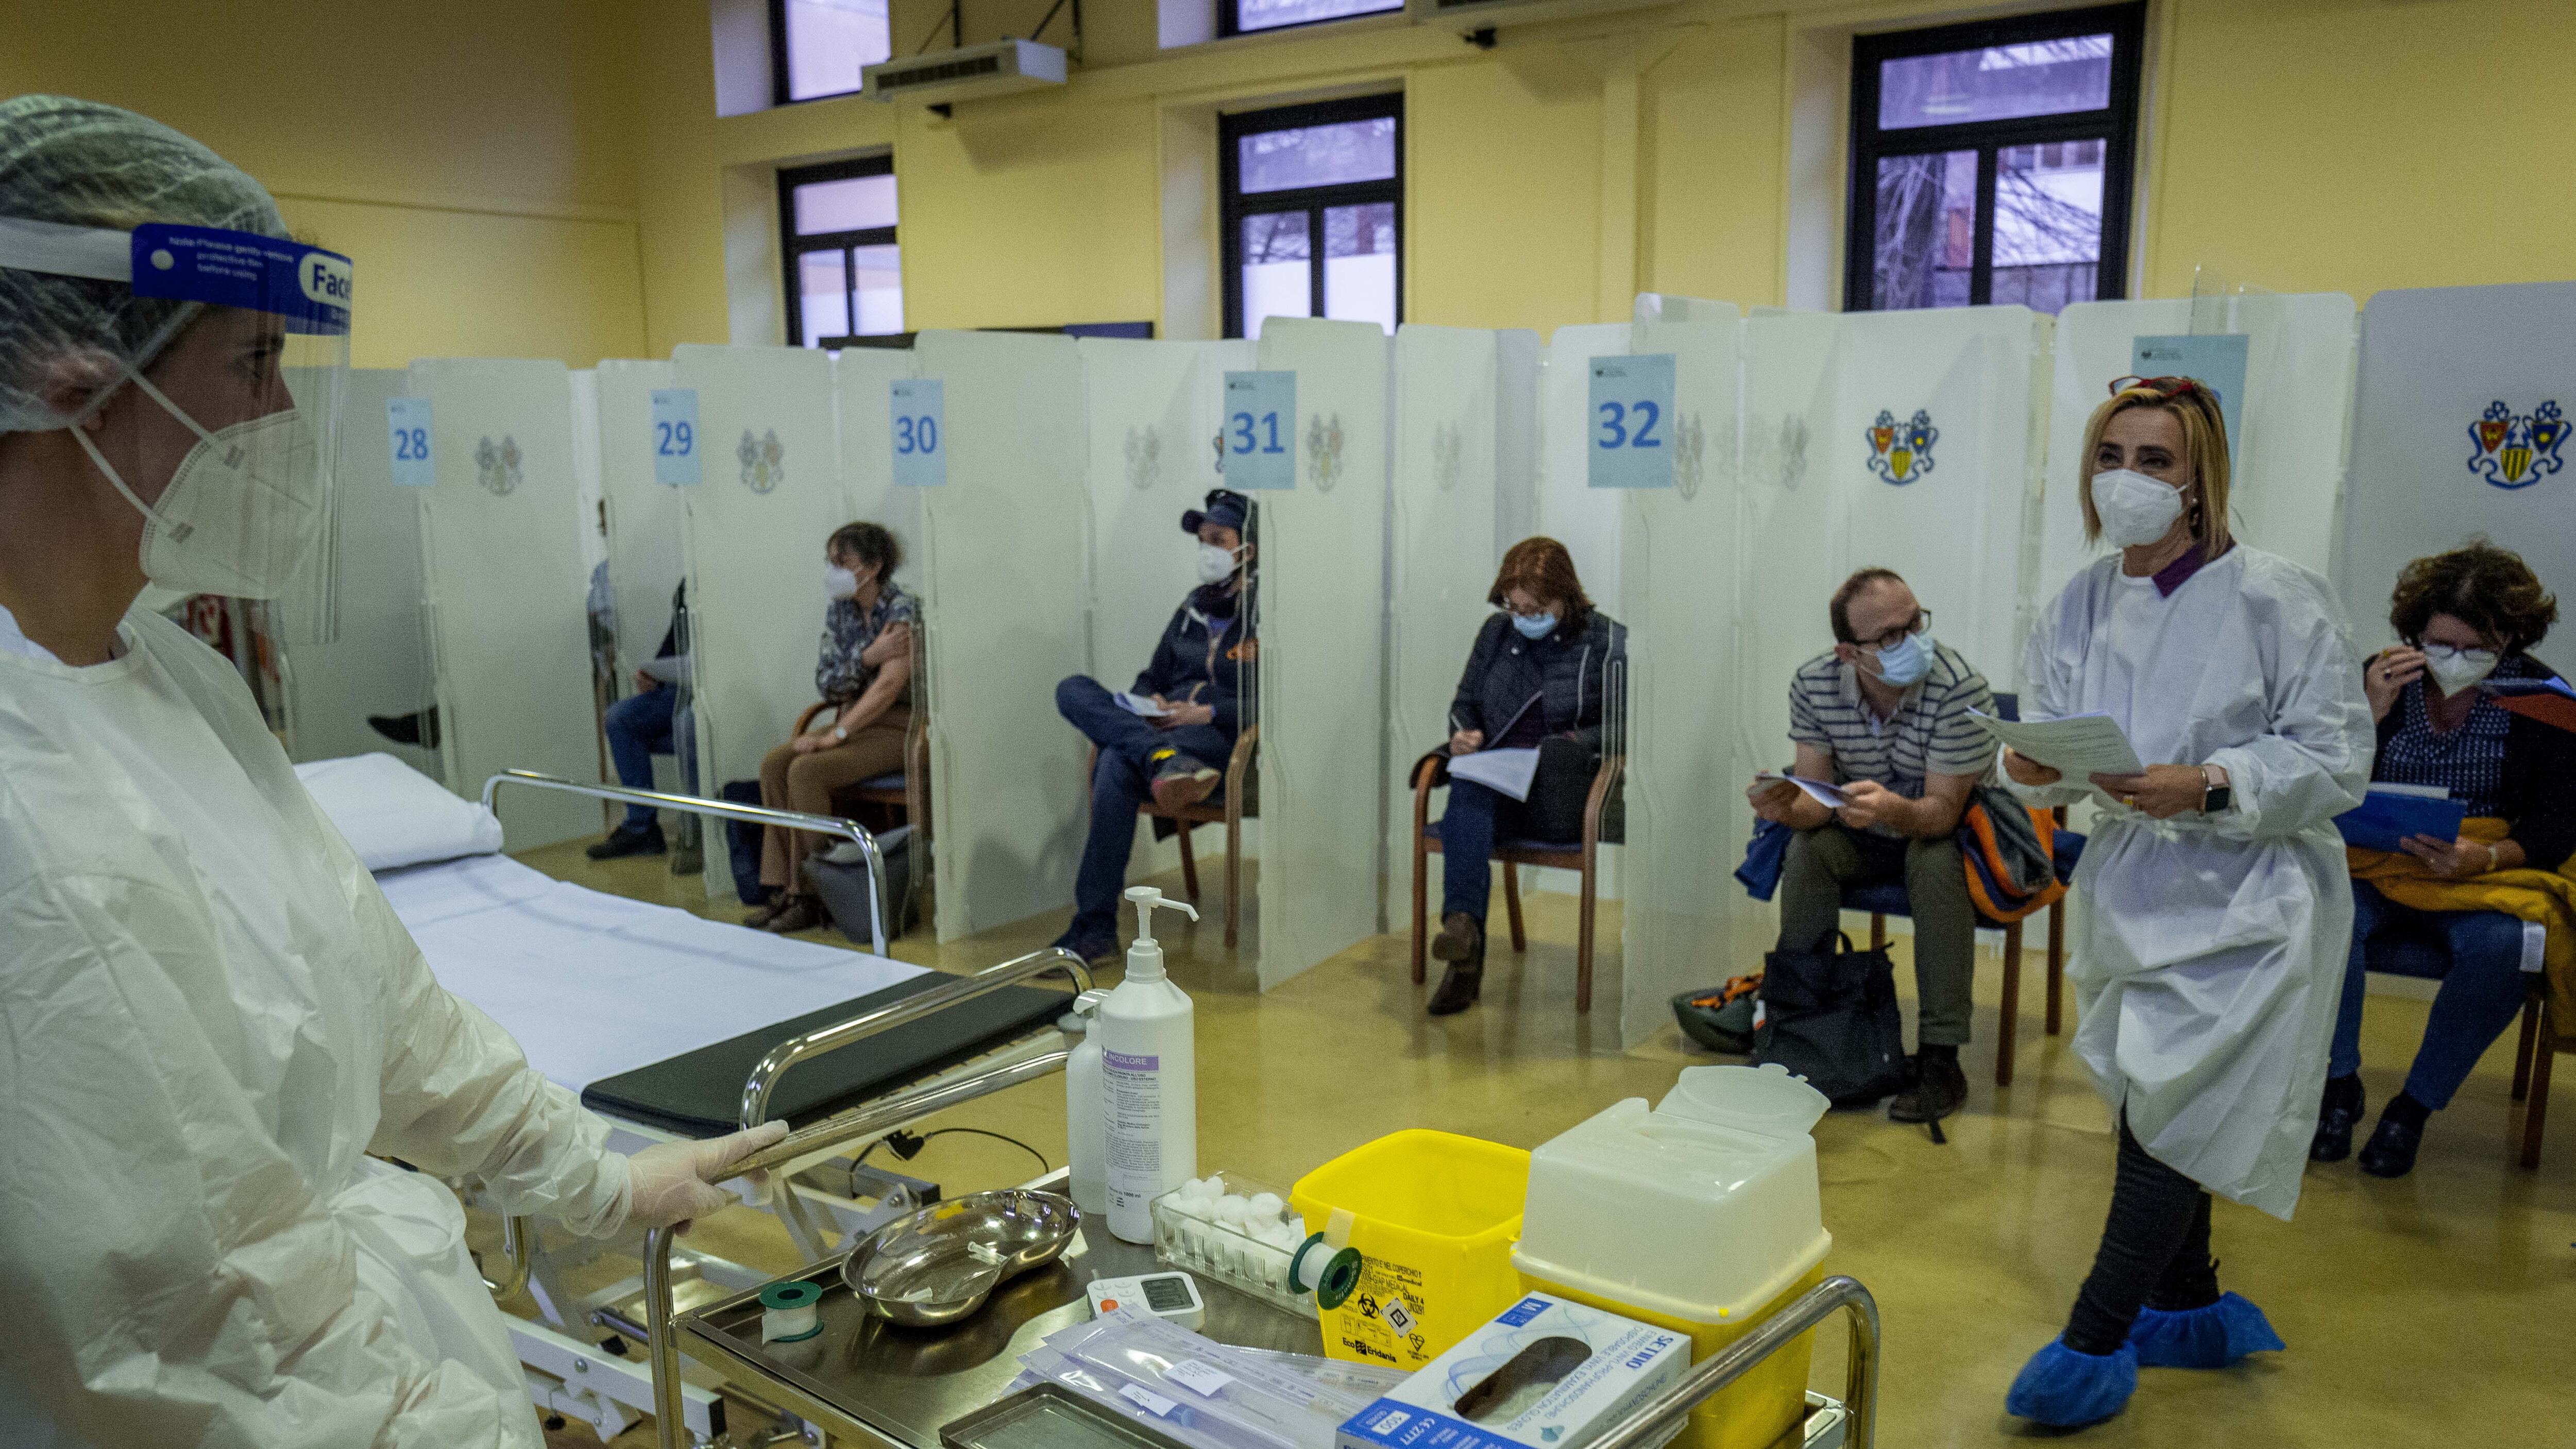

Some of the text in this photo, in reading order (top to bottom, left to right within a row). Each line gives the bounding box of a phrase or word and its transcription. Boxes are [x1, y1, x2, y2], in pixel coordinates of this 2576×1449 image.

[657, 421, 692, 456] 29
[896, 415, 937, 454] 30
[1232, 412, 1285, 454] 31
[1598, 400, 1661, 449] 32
[394, 428, 429, 461] 28
[1108, 1052, 1147, 1066] INCOLORE
[1403, 1292, 1419, 1304] DAILY
[1343, 1337, 1355, 1349] Eco
[1367, 1345, 1397, 1363] Eridania
